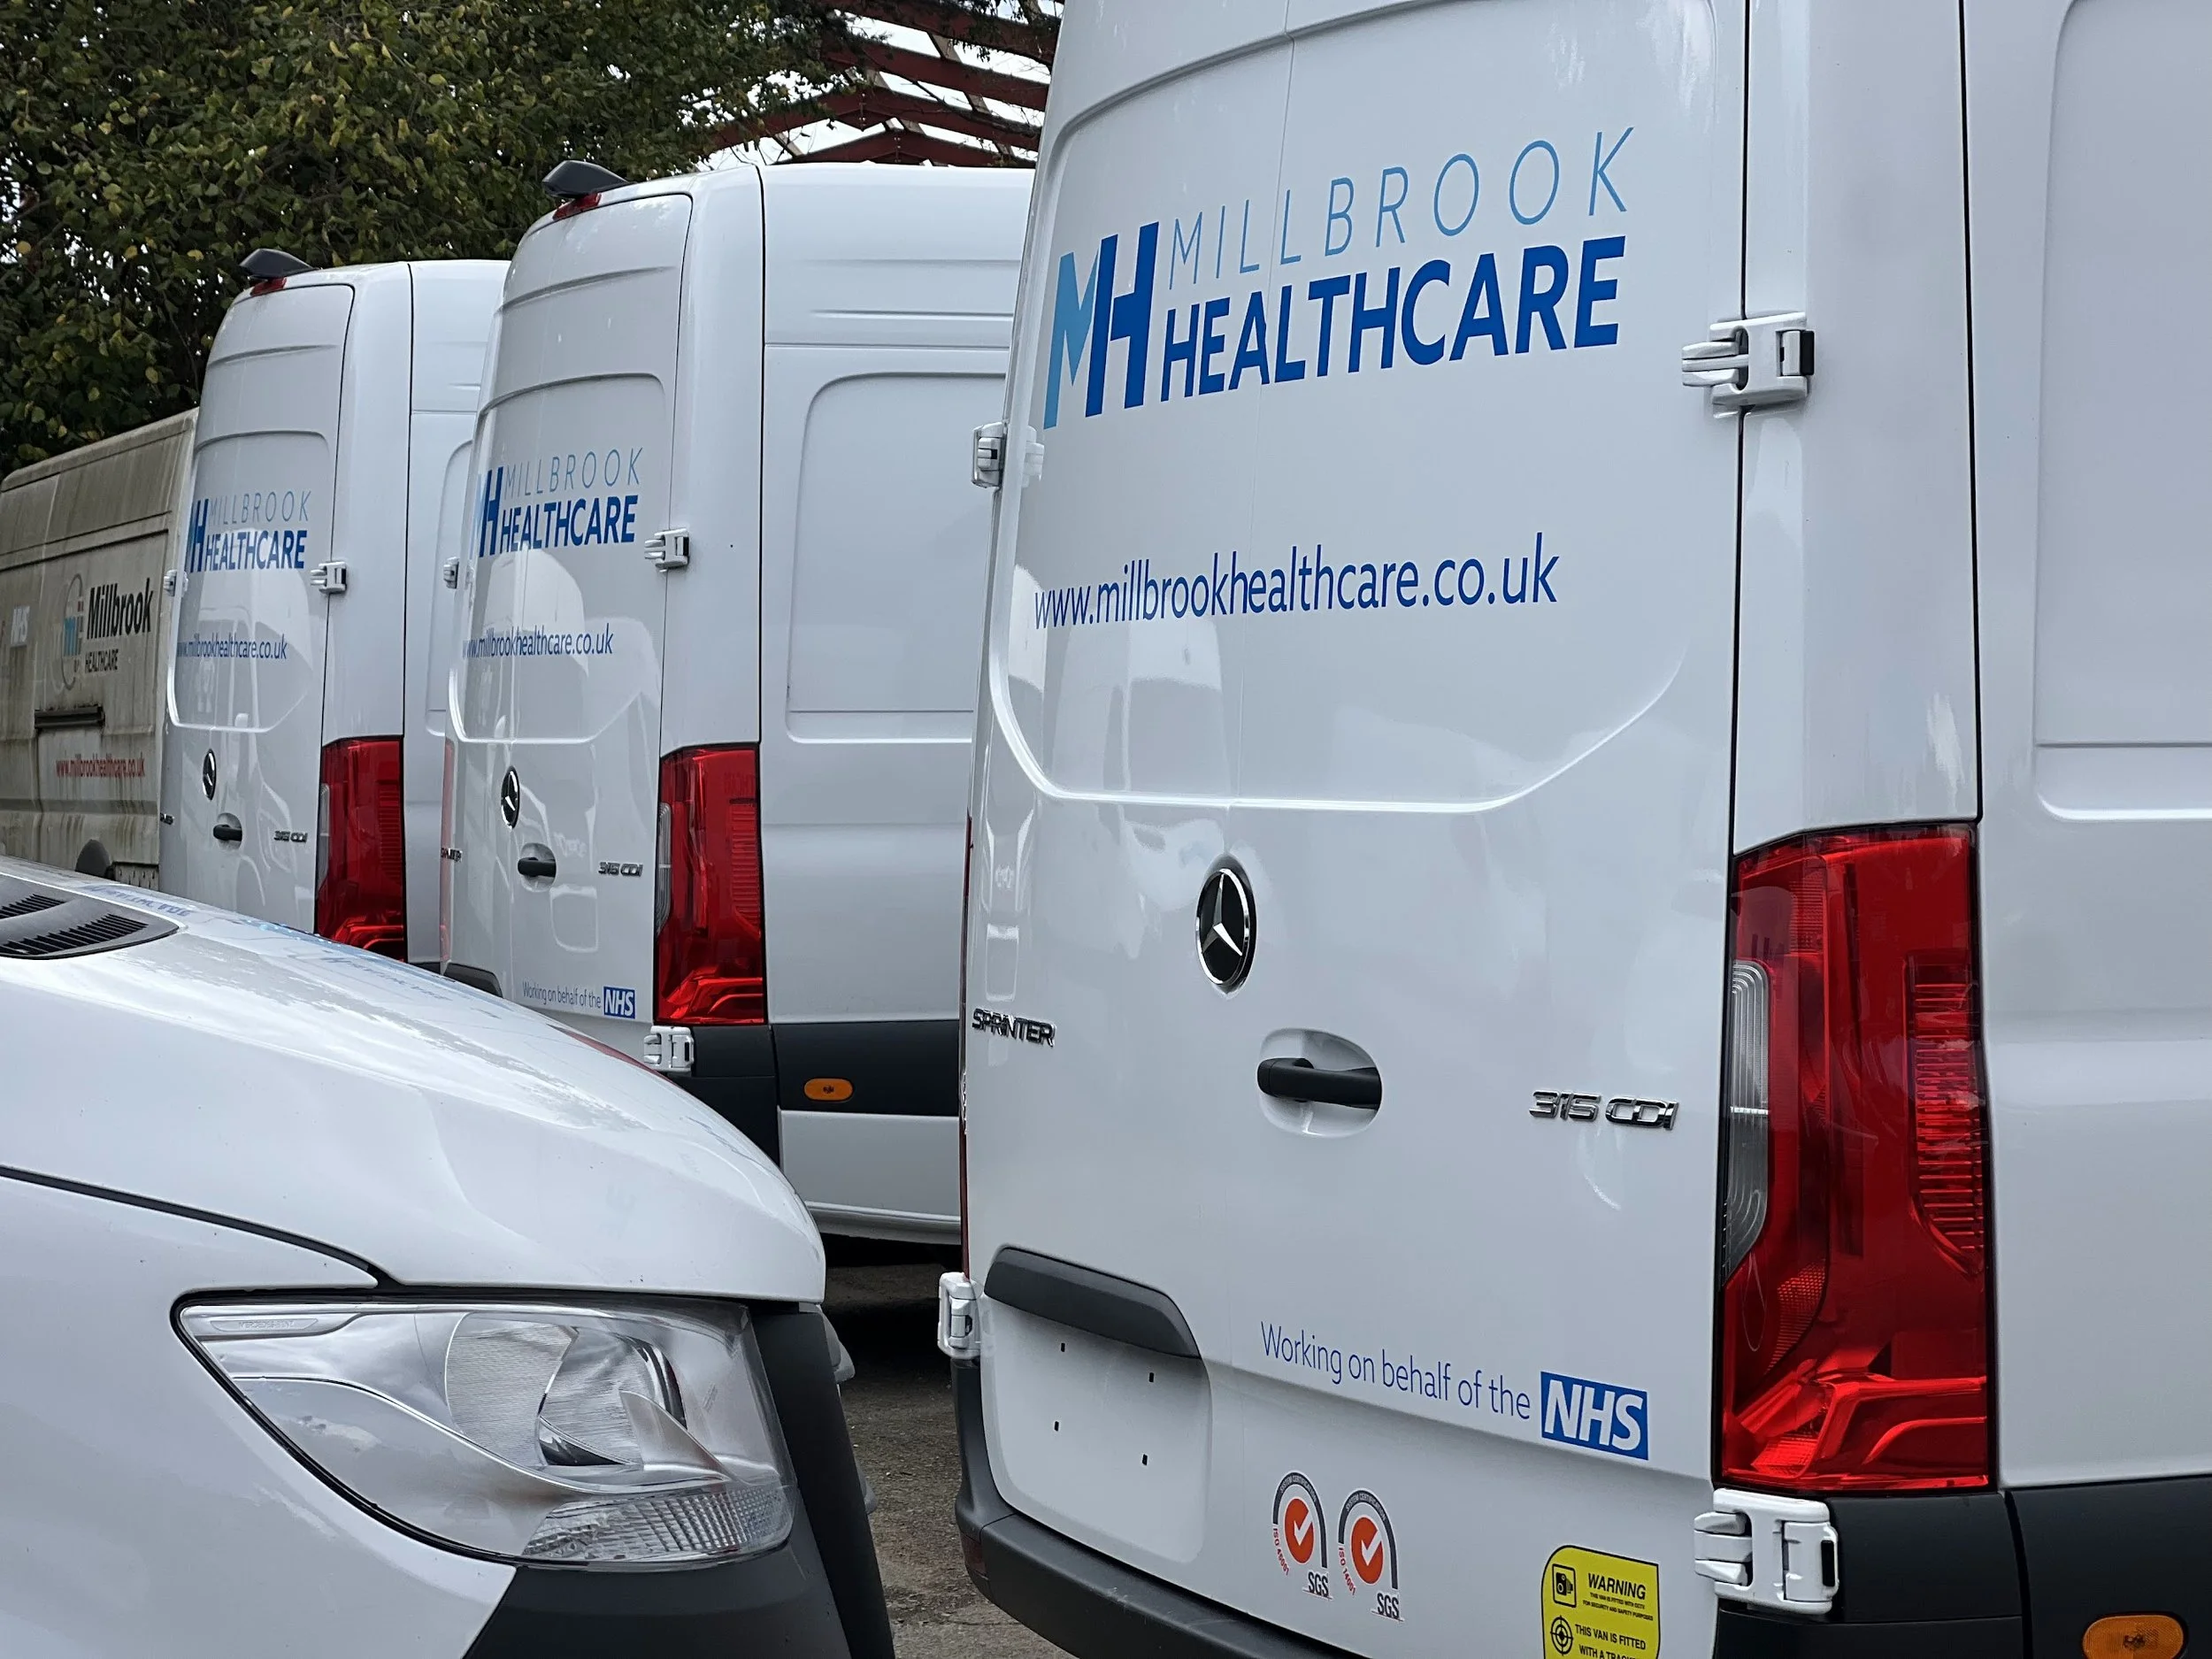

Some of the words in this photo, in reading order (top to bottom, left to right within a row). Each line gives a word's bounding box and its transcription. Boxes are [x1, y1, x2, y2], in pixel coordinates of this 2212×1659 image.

[1168, 127, 1634, 290] MILLBROOK
[1043, 221, 1160, 430] MH
[1160, 235, 1626, 403] HEALTHCARE
[504, 447, 643, 500] MILLBROOK
[209, 490, 311, 526] MILLBROOK
[500, 495, 639, 555] HEALTHCARE
[204, 530, 308, 572] HEALTHCARE
[1034, 532, 1560, 629] www.millbrookhealthcare.co.uk
[87, 577, 154, 640] Millbrook
[557, 985, 579, 1005] behalf
[580, 988, 588, 1006] of
[588, 991, 602, 1009] the
[603, 988, 634, 1017] NHS
[972, 1008, 1056, 1048] SPRINTER
[1529, 1089, 1601, 1121] 315
[1605, 1095, 1679, 1131] CDI
[1261, 1321, 1342, 1385] Working
[1348, 1352, 1375, 1384] on
[1382, 1349, 1451, 1402] behalf
[1458, 1369, 1484, 1409] of
[1488, 1375, 1532, 1420] the
[1543, 1379, 1645, 1452] NHS
[1308, 1570, 1330, 1597] SGS
[1588, 1573, 1646, 1600] WARNING
[1377, 1592, 1400, 1619] SGS
[1575, 1624, 1592, 1637] THIS
[1593, 1628, 1608, 1641] VAN
[1610, 1632, 1617, 1644] IS
[1619, 1635, 1646, 1650] FITTED
[1578, 1644, 1598, 1658] WITH
[1600, 1649, 1605, 1659] A
